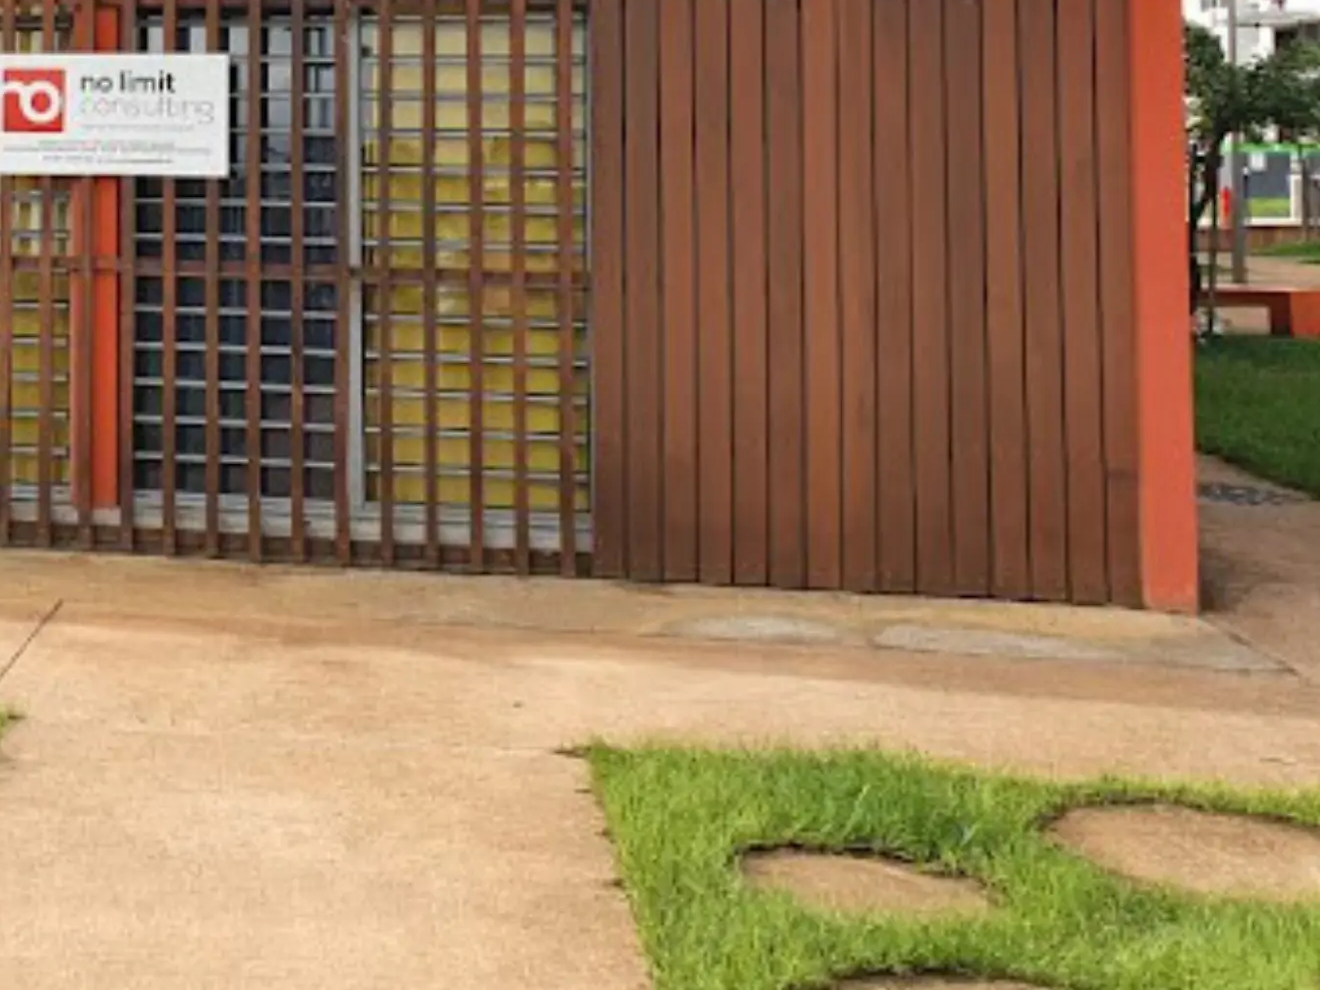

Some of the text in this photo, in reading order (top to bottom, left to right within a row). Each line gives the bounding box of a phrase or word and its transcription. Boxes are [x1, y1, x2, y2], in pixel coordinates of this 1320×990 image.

[80, 69, 177, 95] no limit
[81, 94, 216, 126] consulting
